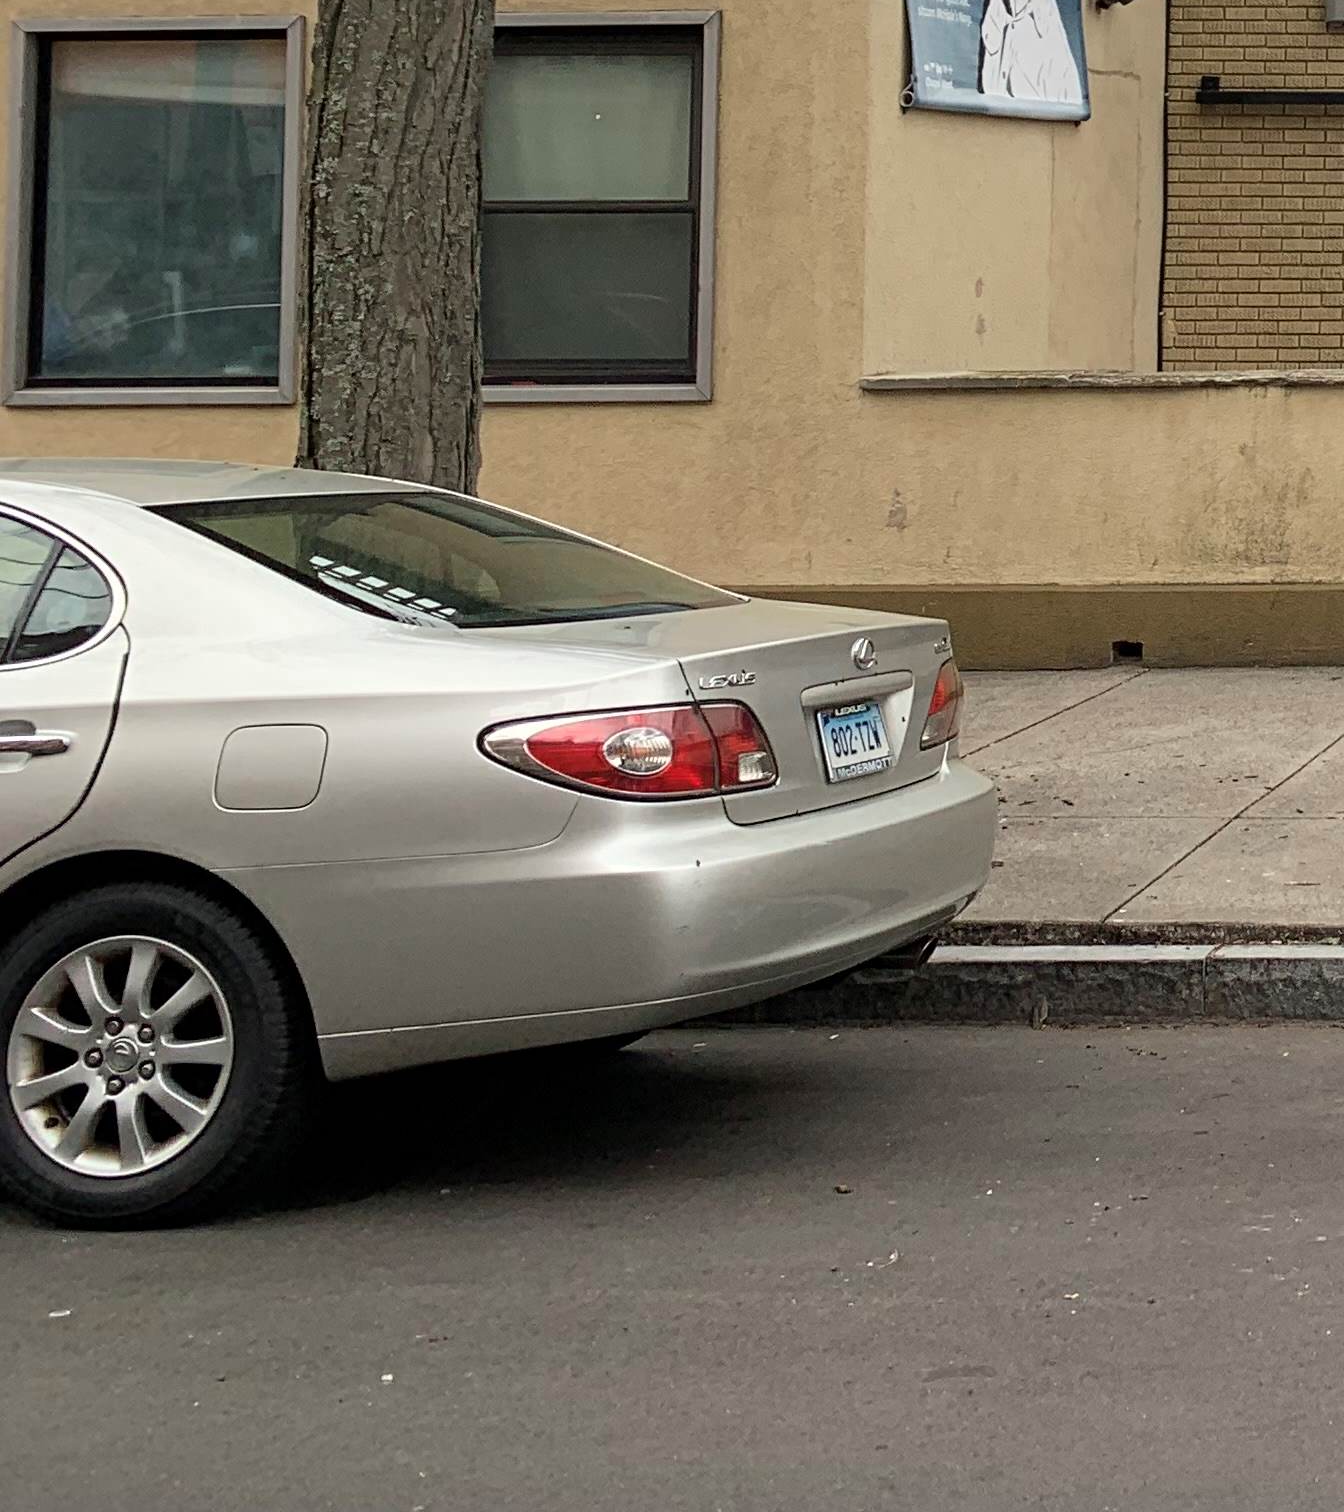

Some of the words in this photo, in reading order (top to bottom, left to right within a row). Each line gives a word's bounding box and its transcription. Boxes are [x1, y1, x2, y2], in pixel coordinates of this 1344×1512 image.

[698, 672, 757, 689] LEXUS
[834, 703, 868, 716] LEXUS
[836, 757, 895, 778] McDERMOTT
